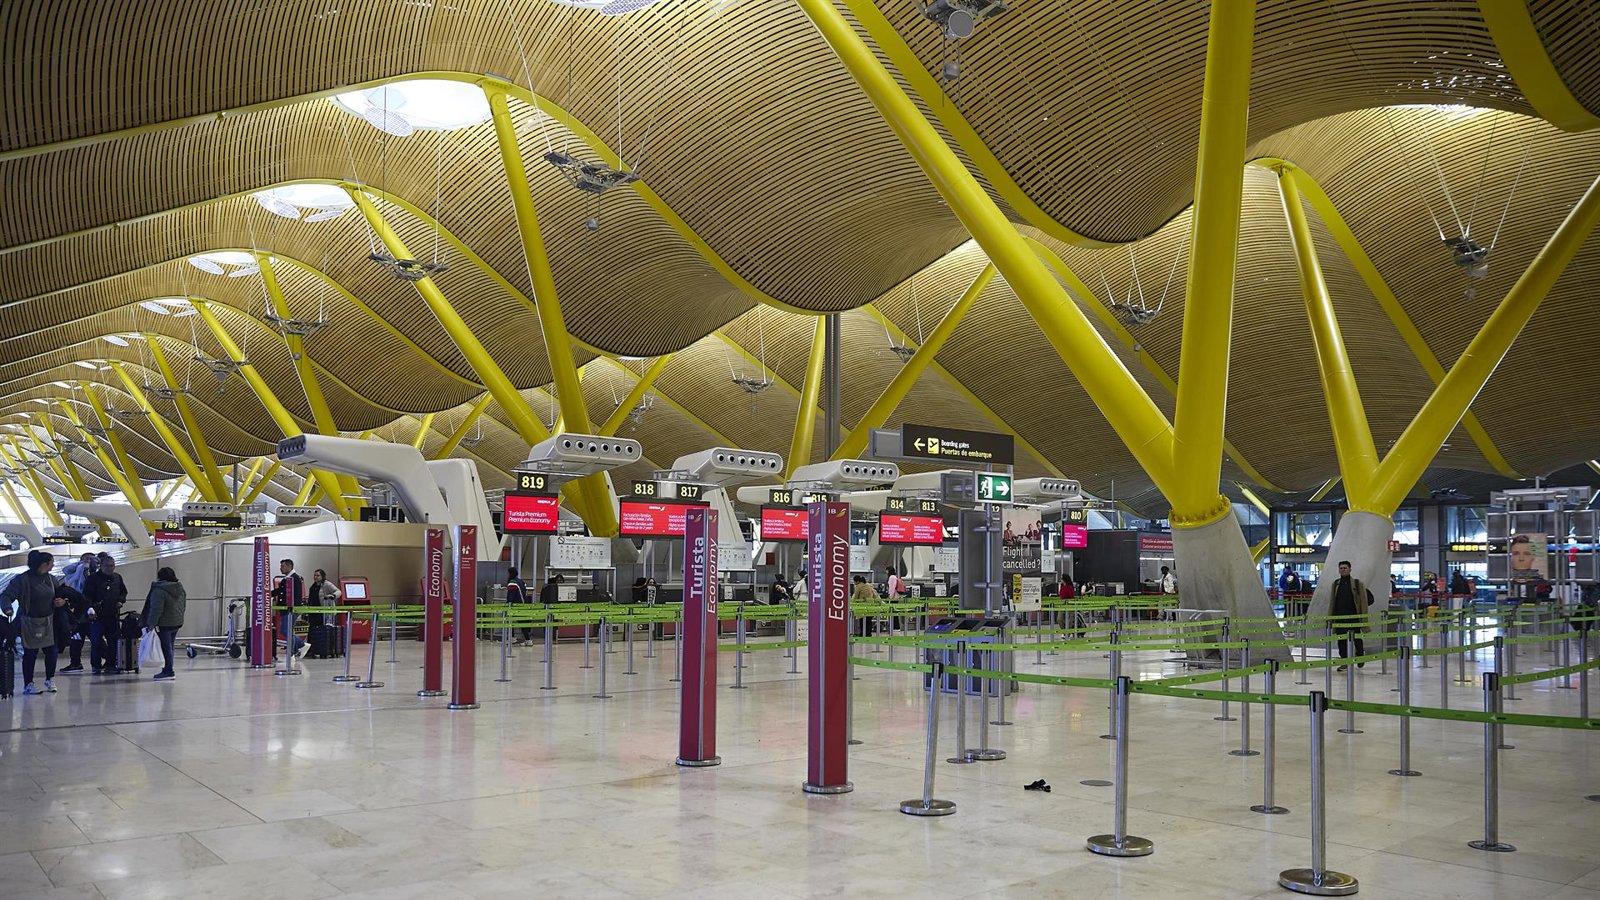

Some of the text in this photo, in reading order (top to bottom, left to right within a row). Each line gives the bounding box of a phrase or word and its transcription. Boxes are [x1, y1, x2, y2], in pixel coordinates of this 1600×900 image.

[941, 440, 958, 448] Boarding
[941, 447, 960, 456] Puertas
[968, 450, 992, 459] embarque
[522, 476, 544, 489] 819
[634, 484, 654, 494] 818
[680, 486, 698, 498] 817
[773, 492, 790, 502] 816
[890, 500, 904, 508] 814
[922, 502, 936, 511] 813
[1070, 511, 1082, 520] 810
[1002, 546, 1023, 559] Flight
[429, 548, 443, 597] Economy
[690, 537, 704, 598] Turista
[812, 533, 822, 602] Turista
[708, 538, 718, 614] Economy
[828, 534, 849, 620] Economy
